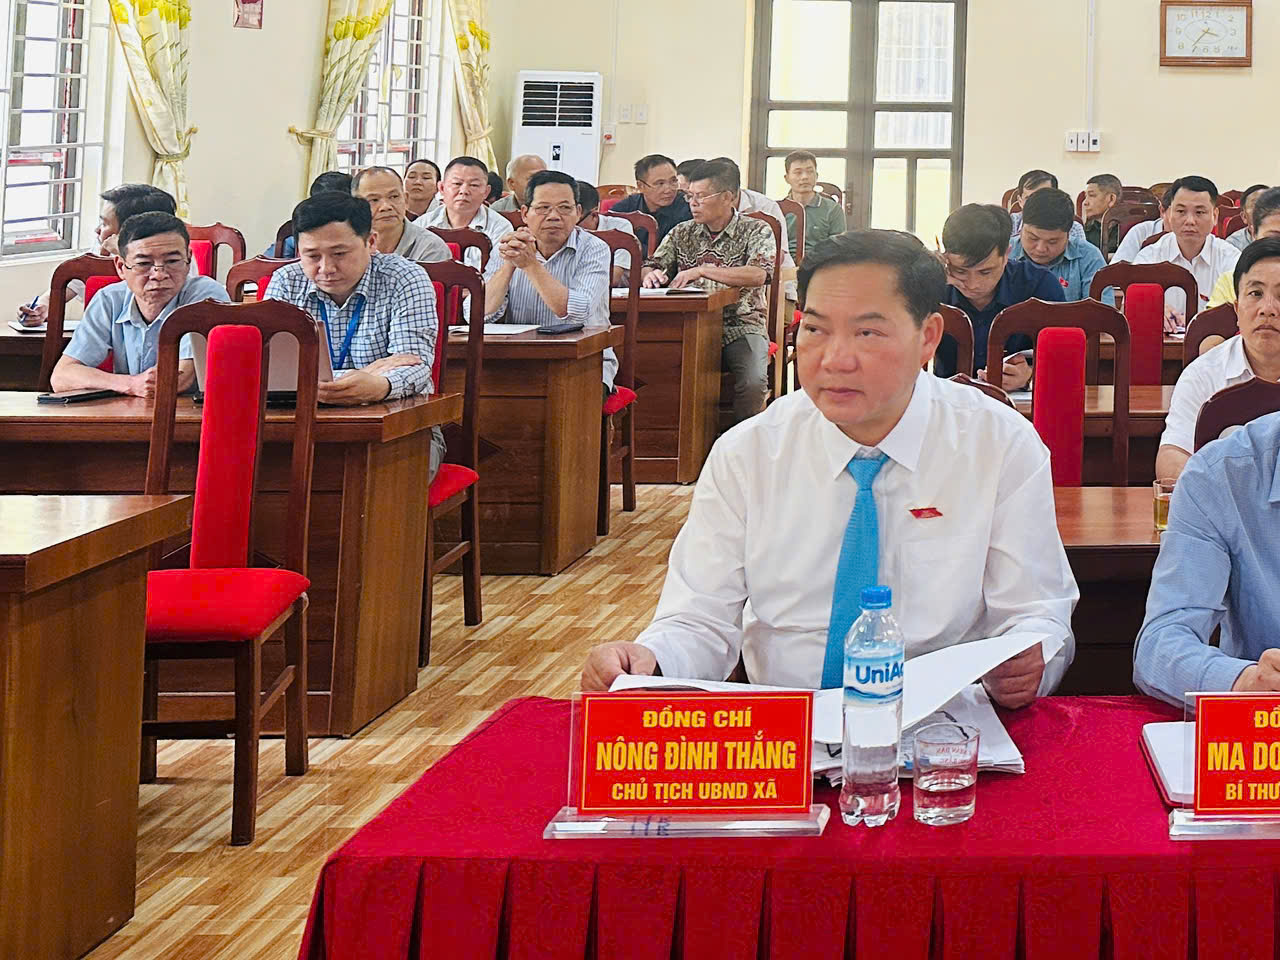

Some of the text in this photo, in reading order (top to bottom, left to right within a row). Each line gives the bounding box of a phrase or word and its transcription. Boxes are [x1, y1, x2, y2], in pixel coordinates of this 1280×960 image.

[643, 706, 751, 727] ĐỒNG CHÍ
[597, 731, 796, 770] NÔNG ĐÌNH THẮNG
[1208, 743, 1245, 770] MA
[612, 778, 776, 803] CHỦ TỊCH UBND XÃ
[1226, 780, 1242, 800] BÍ
[1248, 782, 1280, 799] THƯ
